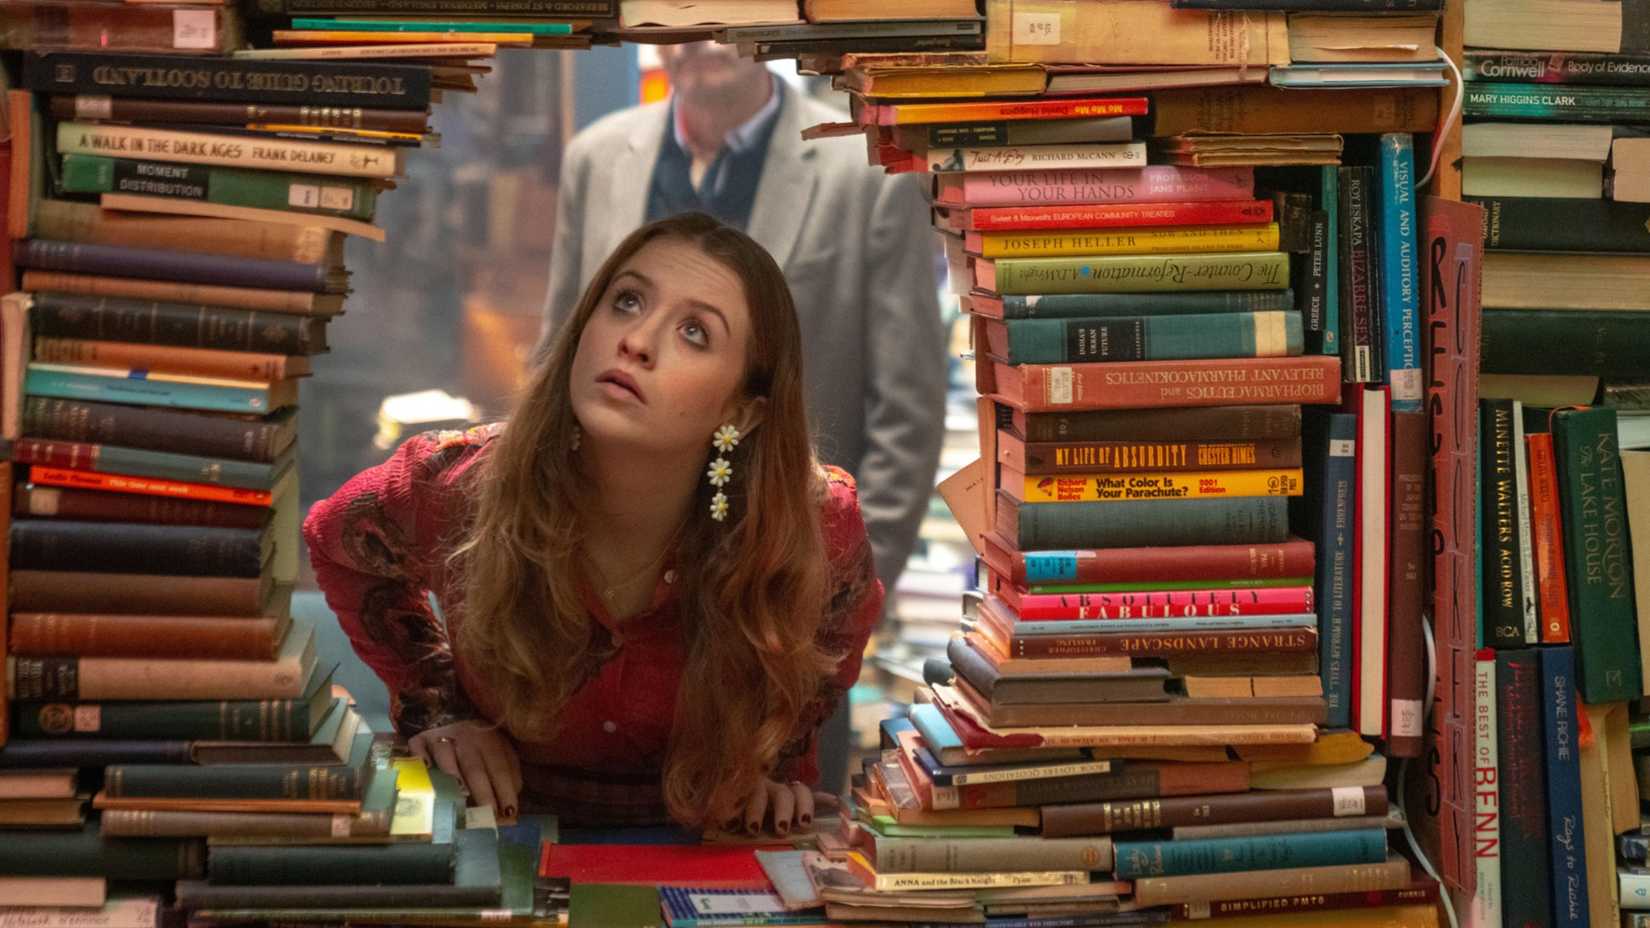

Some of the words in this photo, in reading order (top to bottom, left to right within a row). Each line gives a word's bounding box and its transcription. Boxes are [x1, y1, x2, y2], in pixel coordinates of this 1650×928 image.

[93, 66, 211, 88] SCOTLAND
[1481, 60, 1545, 78] Cornwell
[1568, 62, 1593, 73] Body
[1595, 61, 1606, 72] of
[1607, 61, 1650, 73] Evidenc
[214, 71, 243, 89] TO
[246, 72, 308, 92] GUIDE
[312, 74, 405, 95] TOURING
[1470, 94, 1497, 104] MARY
[1500, 95, 1539, 105] HIGGINS
[1541, 96, 1575, 106] CLARK
[80, 134, 89, 146] A
[91, 135, 126, 150] WALK
[130, 137, 143, 150] IN
[147, 138, 169, 152] THE
[173, 140, 207, 156] DARK
[209, 142, 242, 158] AGES
[252, 146, 287, 160] FRANK
[290, 149, 336, 163] DELANEY
[1031, 152, 1074, 162] RICHARD
[1076, 150, 1116, 161] McCANN
[137, 163, 189, 179] MOMENT
[991, 174, 1041, 187] YOUR
[1045, 173, 1078, 186] LIFE
[1086, 173, 1103, 185] IN
[119, 178, 204, 197] DISTRIBUTION
[1017, 187, 1067, 201] YOUR
[1071, 184, 1136, 200] HANDS
[1351, 180, 1361, 201] ROY
[1399, 161, 1409, 204] VISUAL
[1352, 203, 1363, 245] ESKAPA
[1400, 211, 1410, 236] AND
[1003, 239, 1063, 250] JOSEPH
[1072, 236, 1136, 249] HELLER
[1315, 223, 1323, 247] LUNN
[1092, 259, 1254, 285] Counter-Reformation
[1313, 249, 1322, 276] PETER
[1400, 241, 1412, 303] AUDITORY
[1259, 267, 1281, 286] The
[1352, 251, 1367, 313] BIZARRE
[1311, 296, 1320, 330] GREECE
[1089, 328, 1097, 354] URBAN
[1357, 317, 1368, 344] SEX
[1106, 369, 1247, 385] PHARMACOKINETICS
[1252, 368, 1325, 382] RELEVANT
[1160, 387, 1183, 399] and
[1187, 384, 1325, 399] BIOPHARMACEUTICS
[1495, 409, 1511, 473] MINETTE
[1056, 447, 1070, 466] MY
[1073, 447, 1095, 465] LIFE
[1100, 447, 1110, 464] OF
[1114, 444, 1188, 468] ABSURDITY
[1198, 444, 1230, 465] CHESTER
[1232, 443, 1256, 464] HIMES
[1599, 432, 1615, 489] KATE
[1057, 478, 1087, 486] Richard
[1096, 477, 1126, 488] What
[1129, 477, 1159, 488] Color
[1163, 477, 1173, 487] Is
[1096, 488, 1123, 499] Your
[1125, 486, 1188, 498] Parachute?
[1199, 486, 1226, 494] Edition
[1580, 472, 1595, 515] LAKE
[1497, 479, 1512, 544] WALTERS
[1584, 520, 1602, 585] HOUSE
[1601, 495, 1626, 599] MORTON
[1499, 549, 1513, 578] ACID
[1335, 551, 1344, 599] LITERATURE
[1501, 582, 1513, 608] ROW
[1078, 604, 1241, 620] FABULOUS
[1120, 636, 1219, 652] LANDSCAPE
[1228, 633, 1306, 648] STRANGE
[1478, 672, 1488, 699] THE
[1554, 676, 1567, 718] SHANE
[1478, 705, 1489, 740] BEST
[1556, 720, 1569, 760] RICHIE
[1480, 747, 1490, 766] OF
[894, 879, 920, 887] ANNA
[922, 878, 935, 886] and
[937, 878, 948, 886] the
[1220, 899, 1288, 912] SIMPLIFIED
